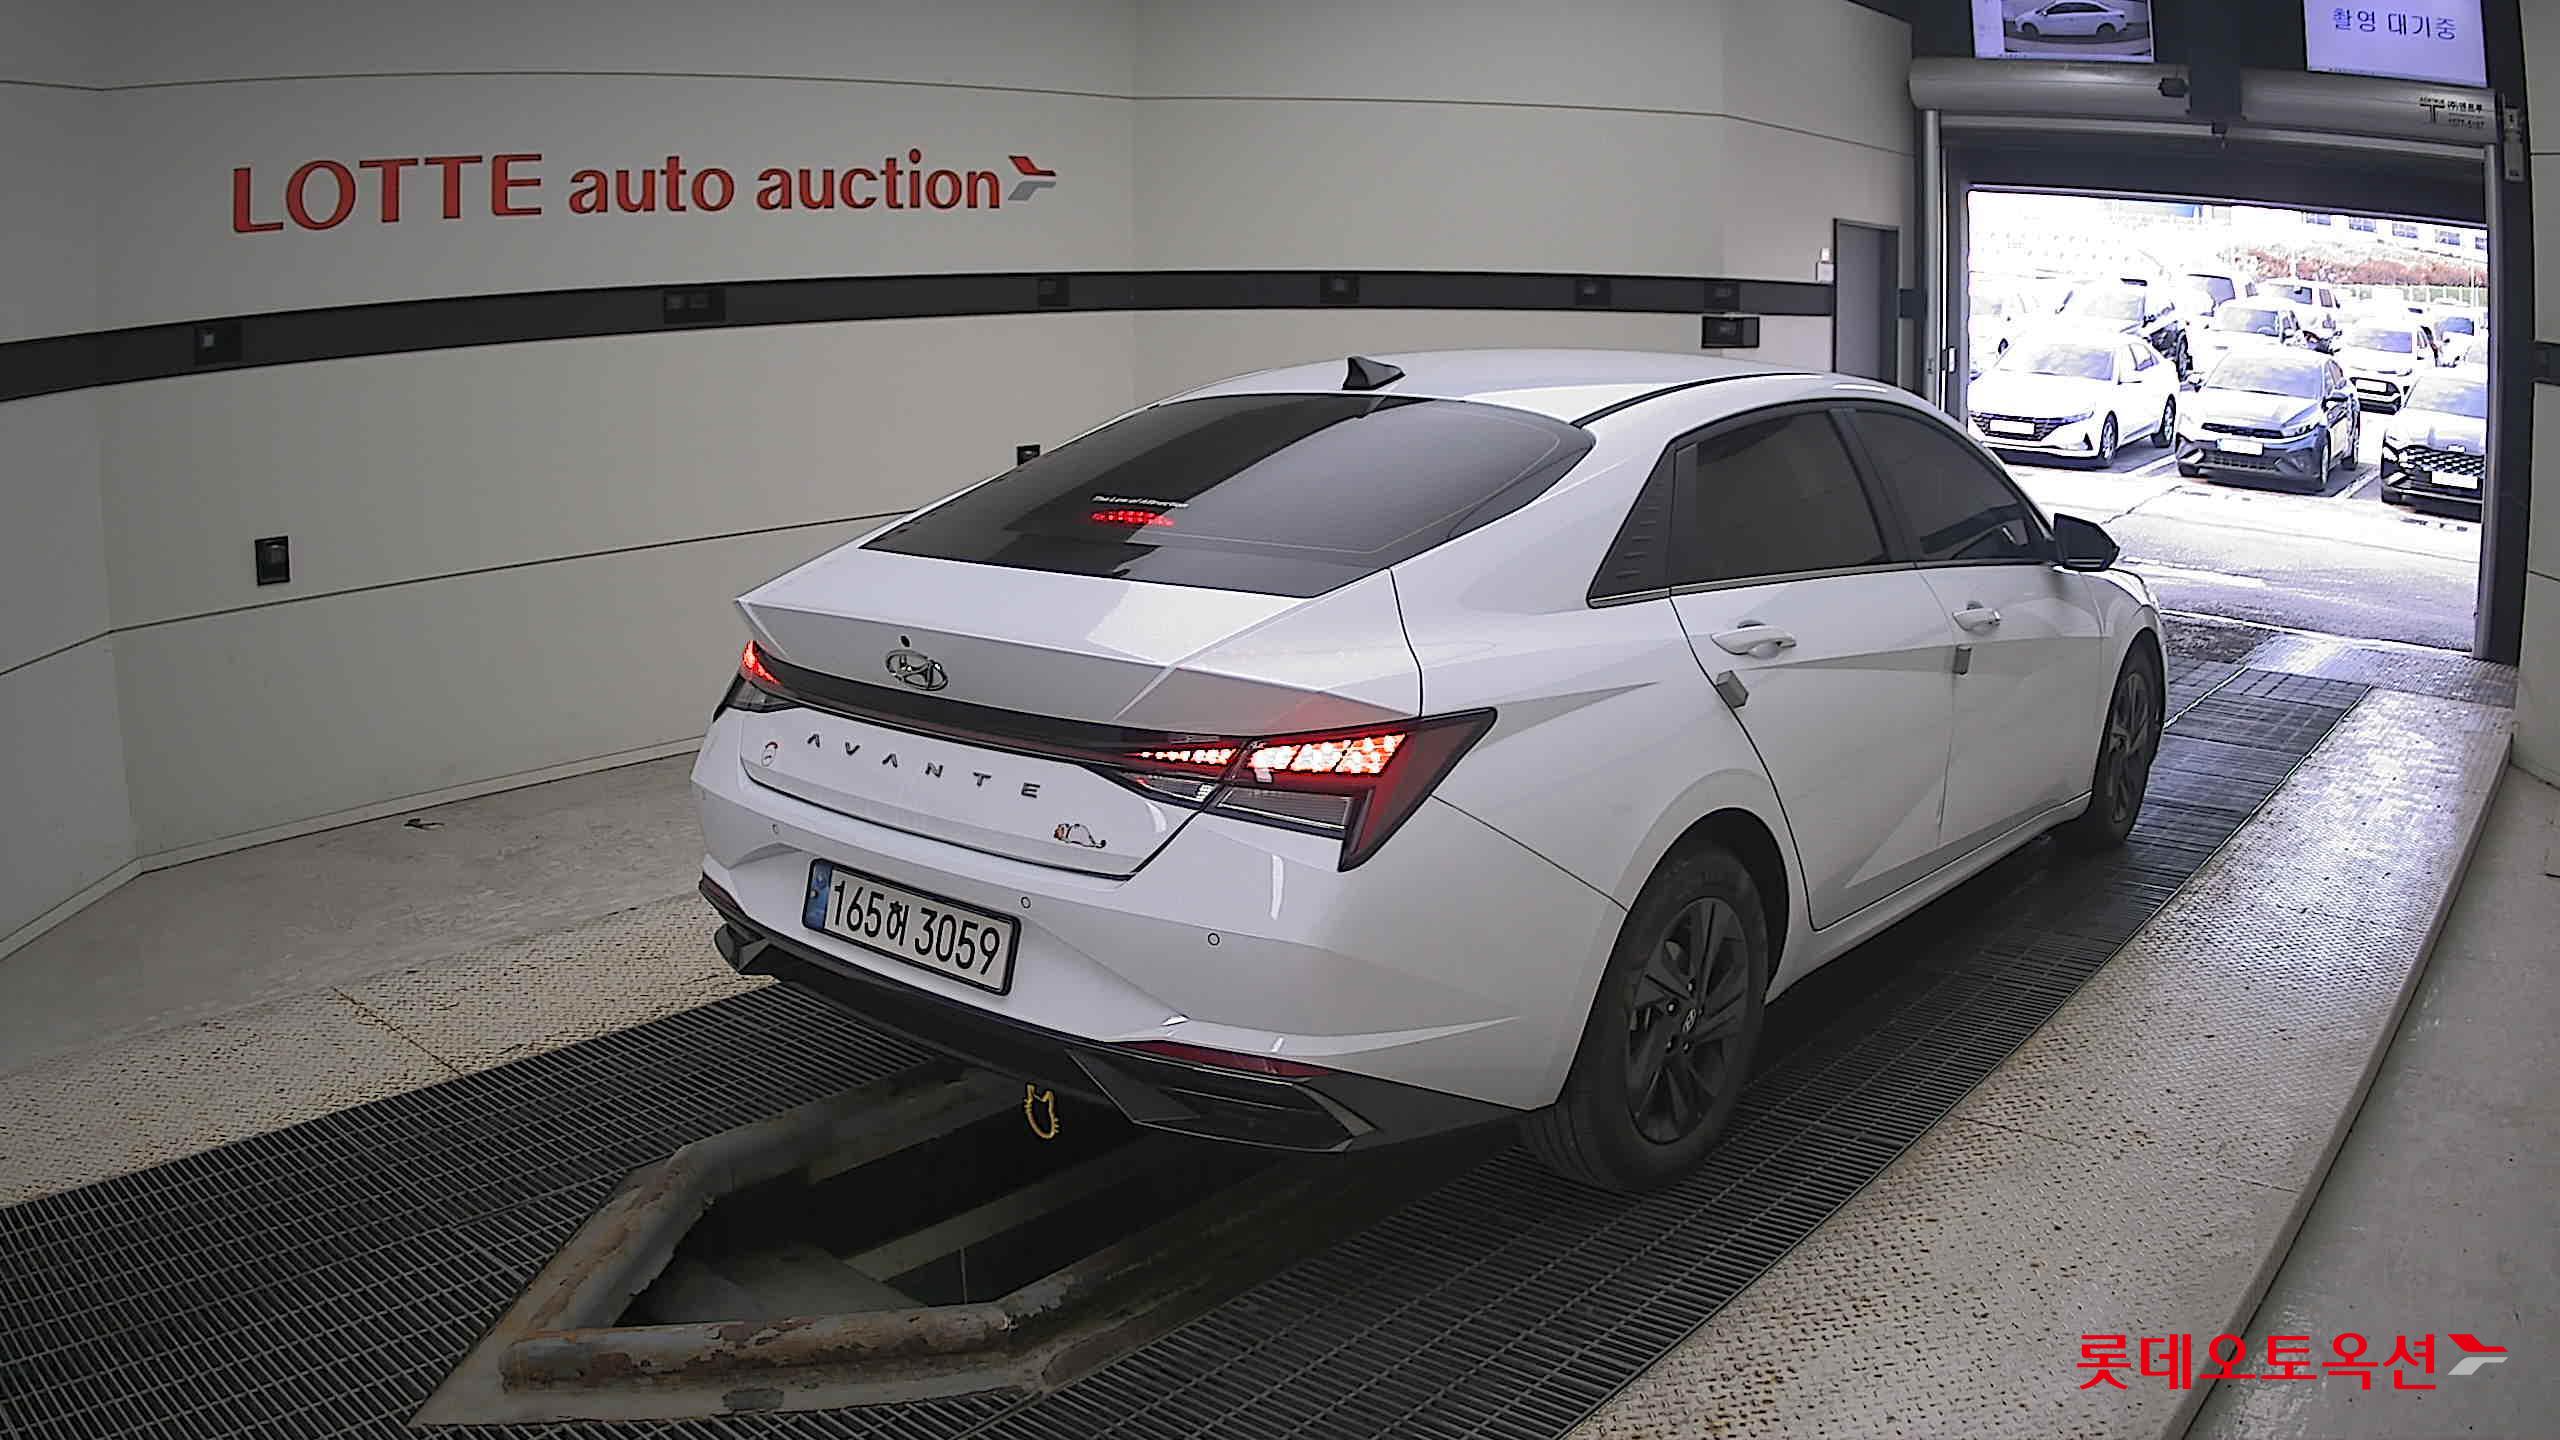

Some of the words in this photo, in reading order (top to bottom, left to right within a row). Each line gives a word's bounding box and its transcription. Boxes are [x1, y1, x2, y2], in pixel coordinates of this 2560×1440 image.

[2333, 8, 2377, 33] 촬영
[2387, 13, 2457, 41] 대기중
[234, 153, 543, 234] LOTTE
[569, 156, 736, 215] auto
[757, 149, 1002, 211] auction
[807, 733, 1041, 799] AVANTE
[834, 880, 909, 946] 165허
[914, 907, 1001, 976] 3059
